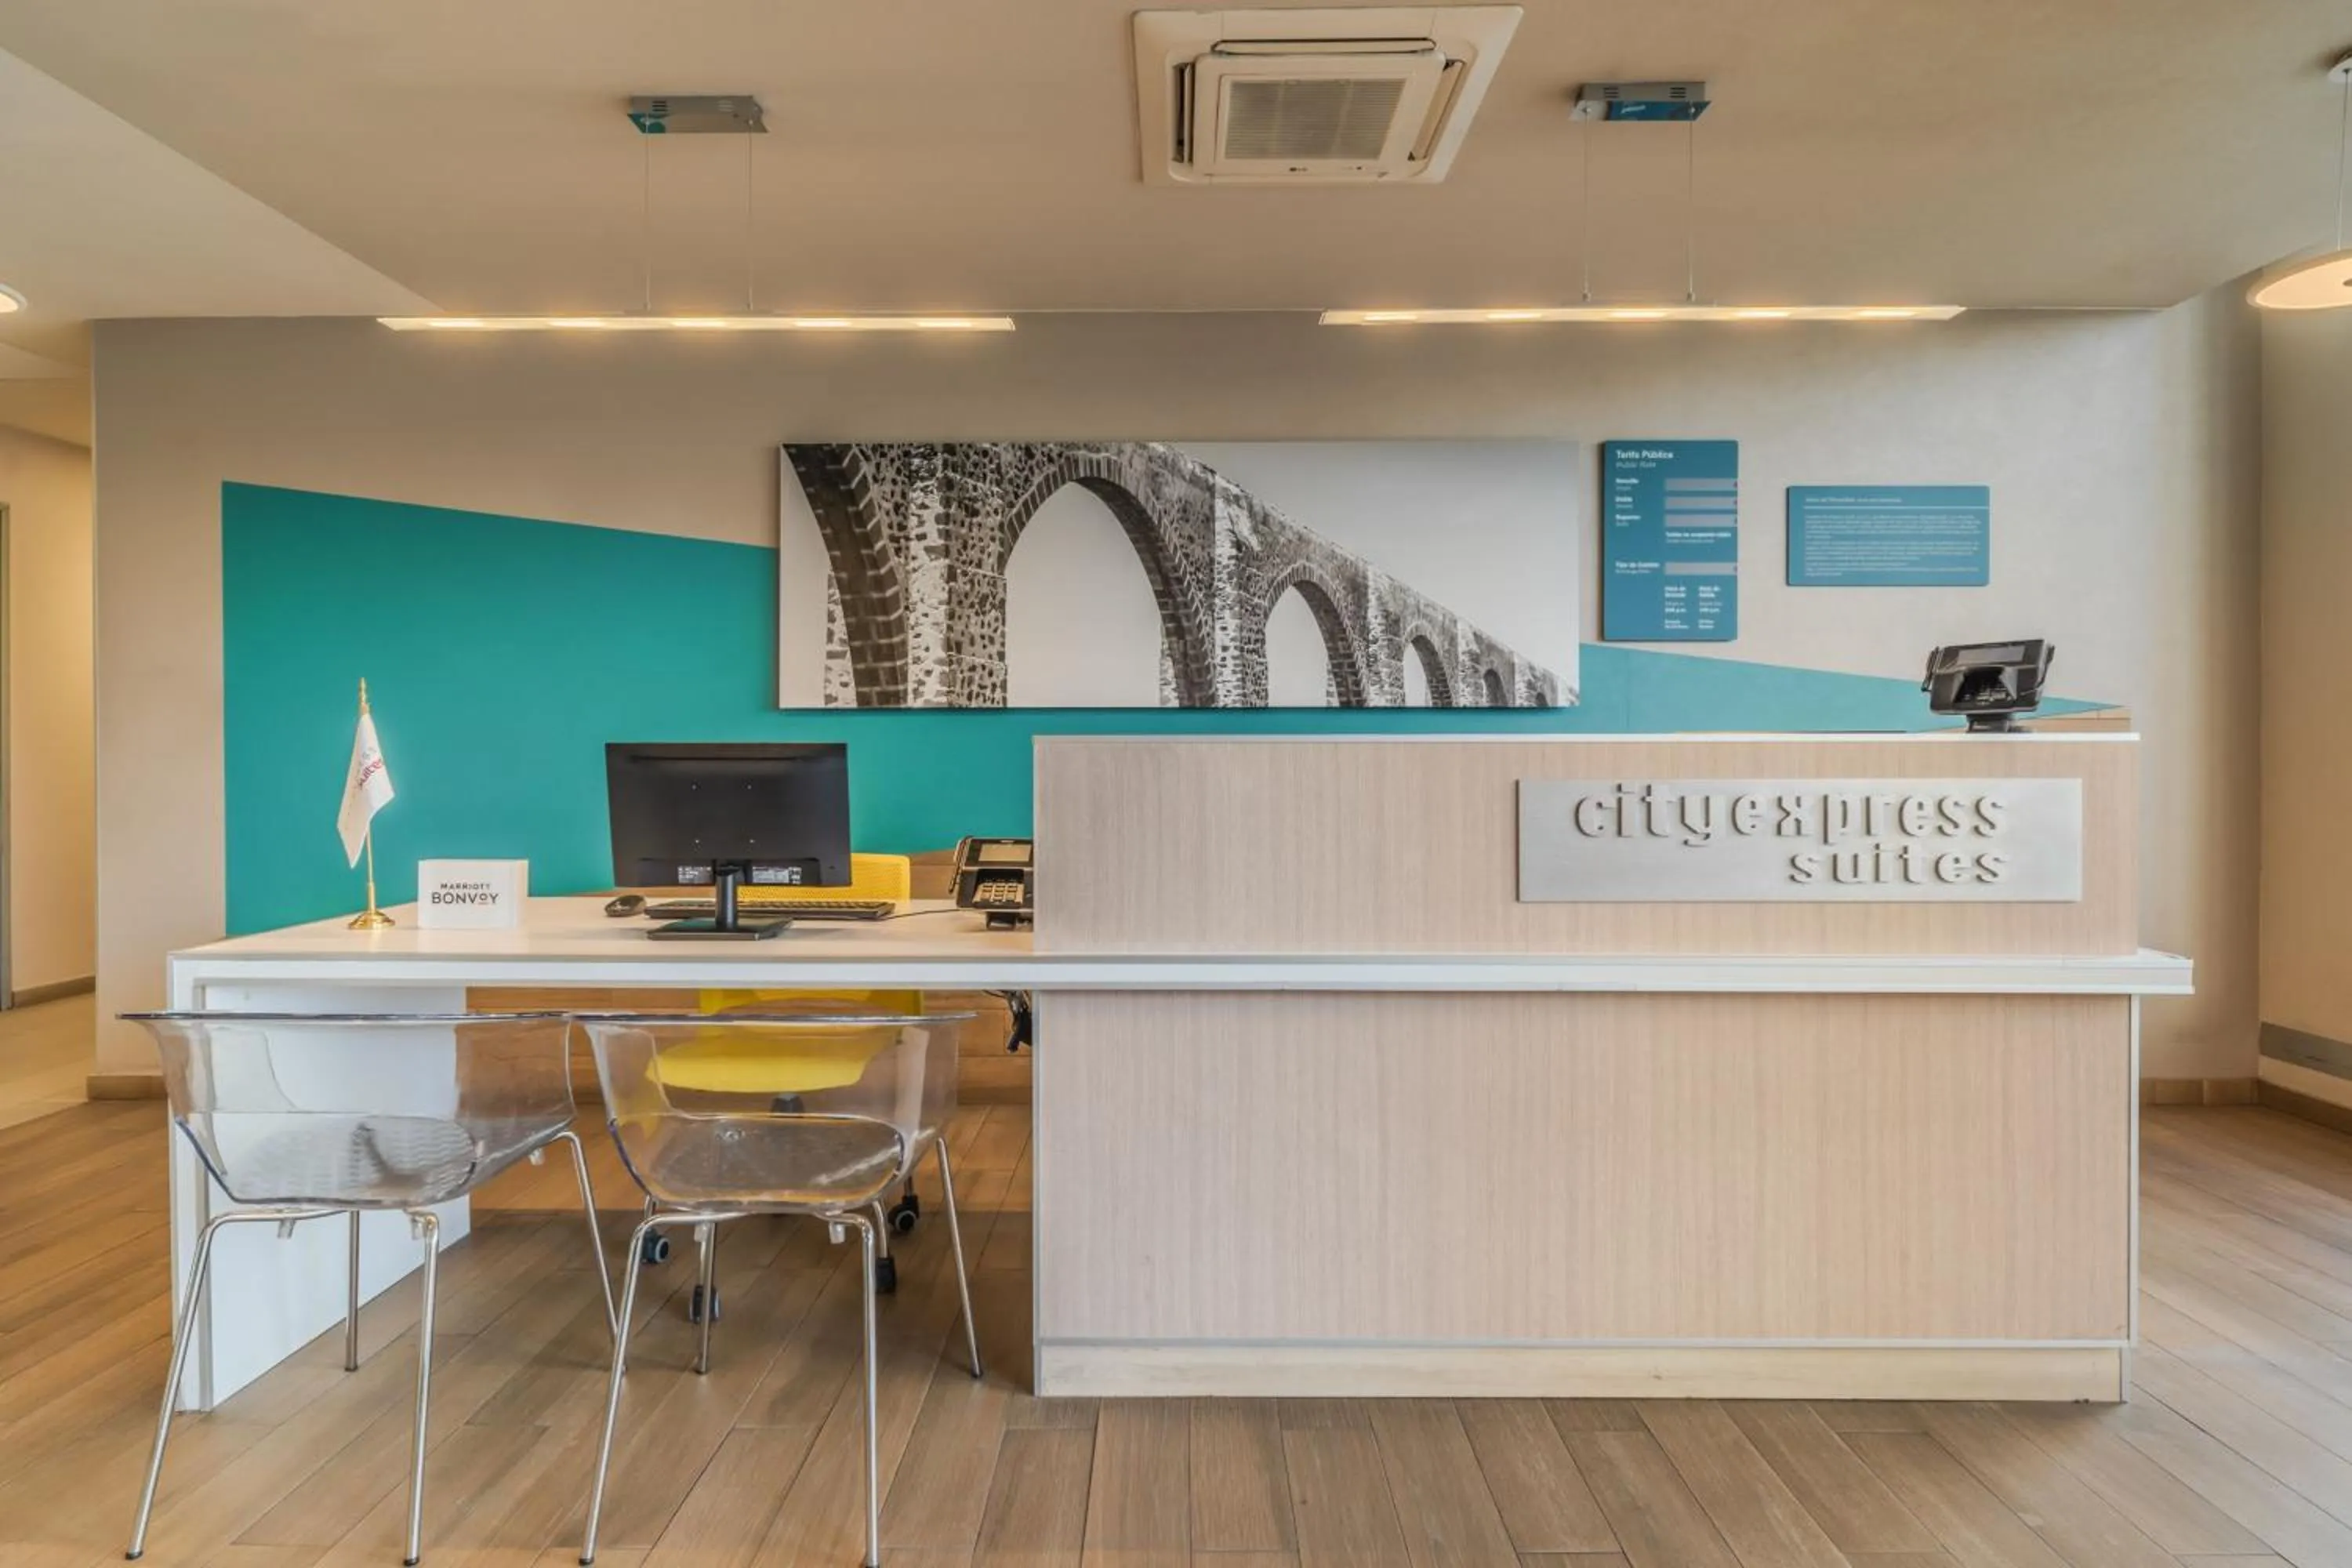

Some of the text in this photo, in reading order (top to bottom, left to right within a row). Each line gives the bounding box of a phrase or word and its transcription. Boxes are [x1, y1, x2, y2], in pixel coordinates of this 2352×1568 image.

[1788, 843, 2009, 884] suites
[440, 882, 491, 891] MARRIOTT
[431, 891, 499, 905] BONVOY
